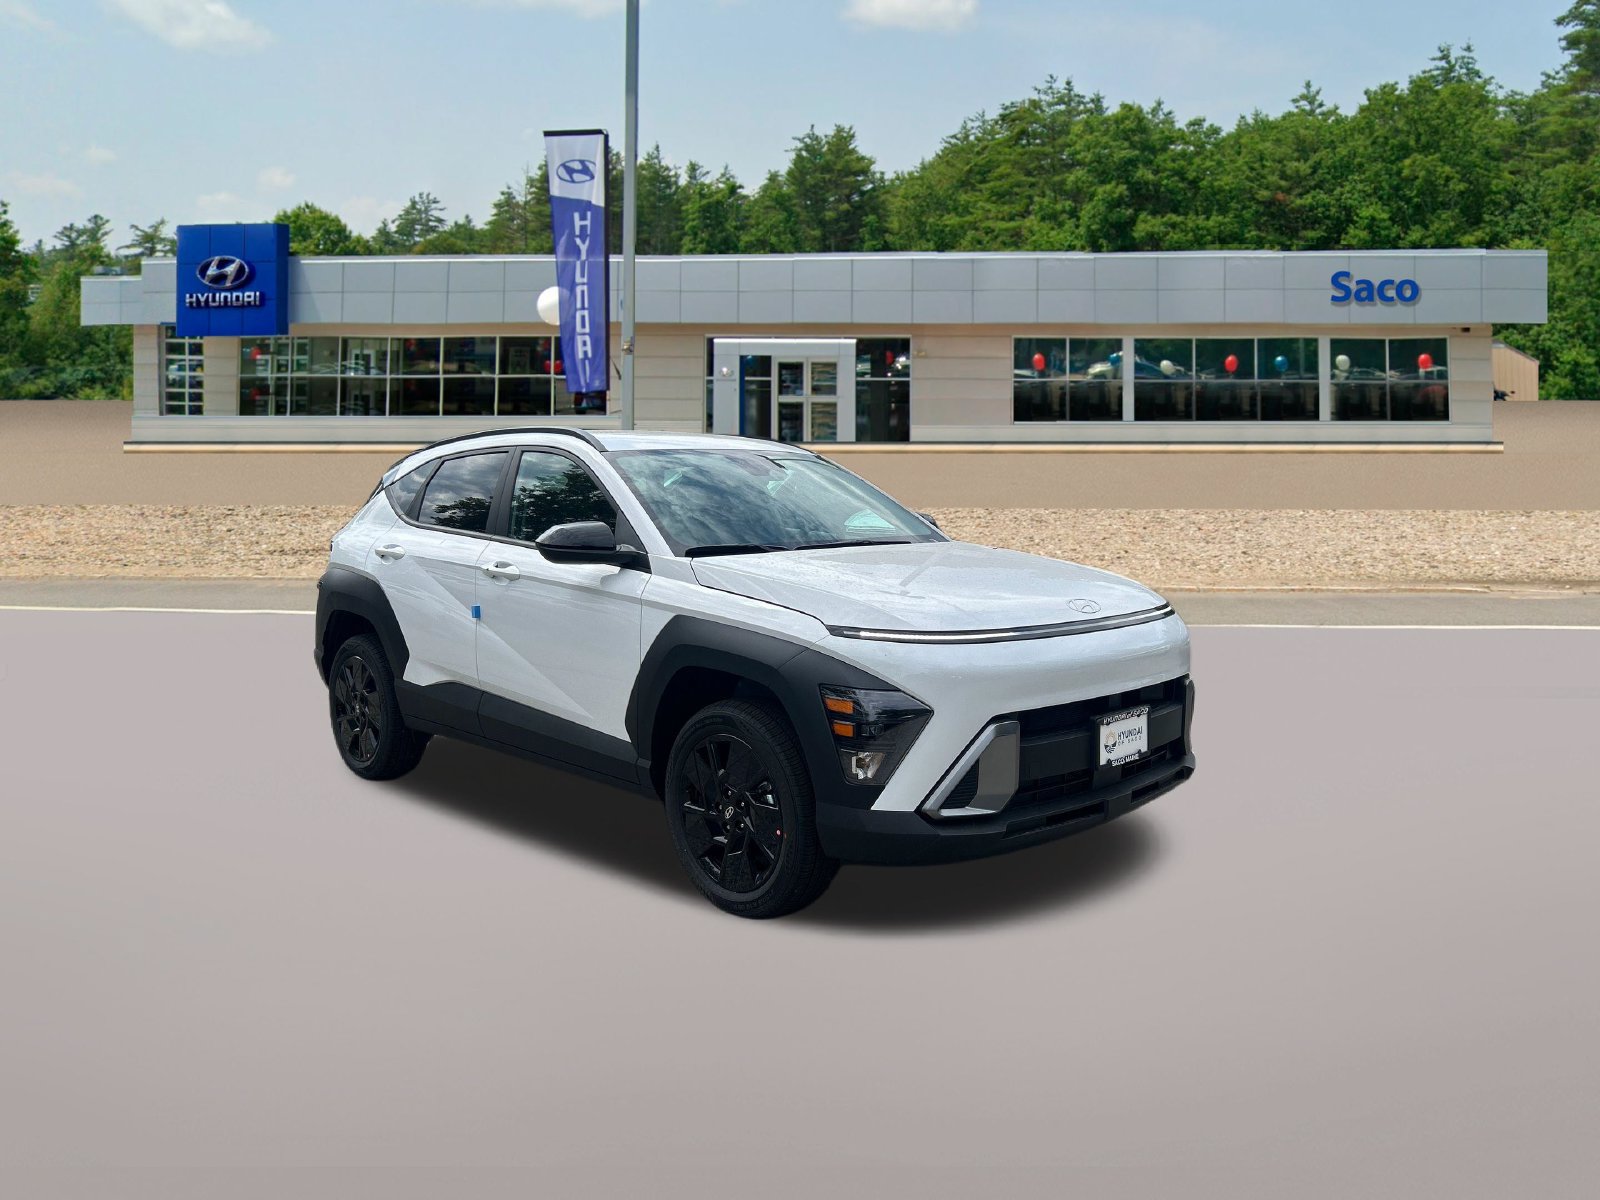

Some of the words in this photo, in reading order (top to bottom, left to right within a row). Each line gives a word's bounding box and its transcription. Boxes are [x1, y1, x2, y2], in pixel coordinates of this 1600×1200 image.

[573, 210, 592, 383] HYUNDAI
[1330, 270, 1420, 303] Saco
[185, 291, 260, 307] HYUNDAI
[1118, 726, 1142, 740] HYUNDAI
